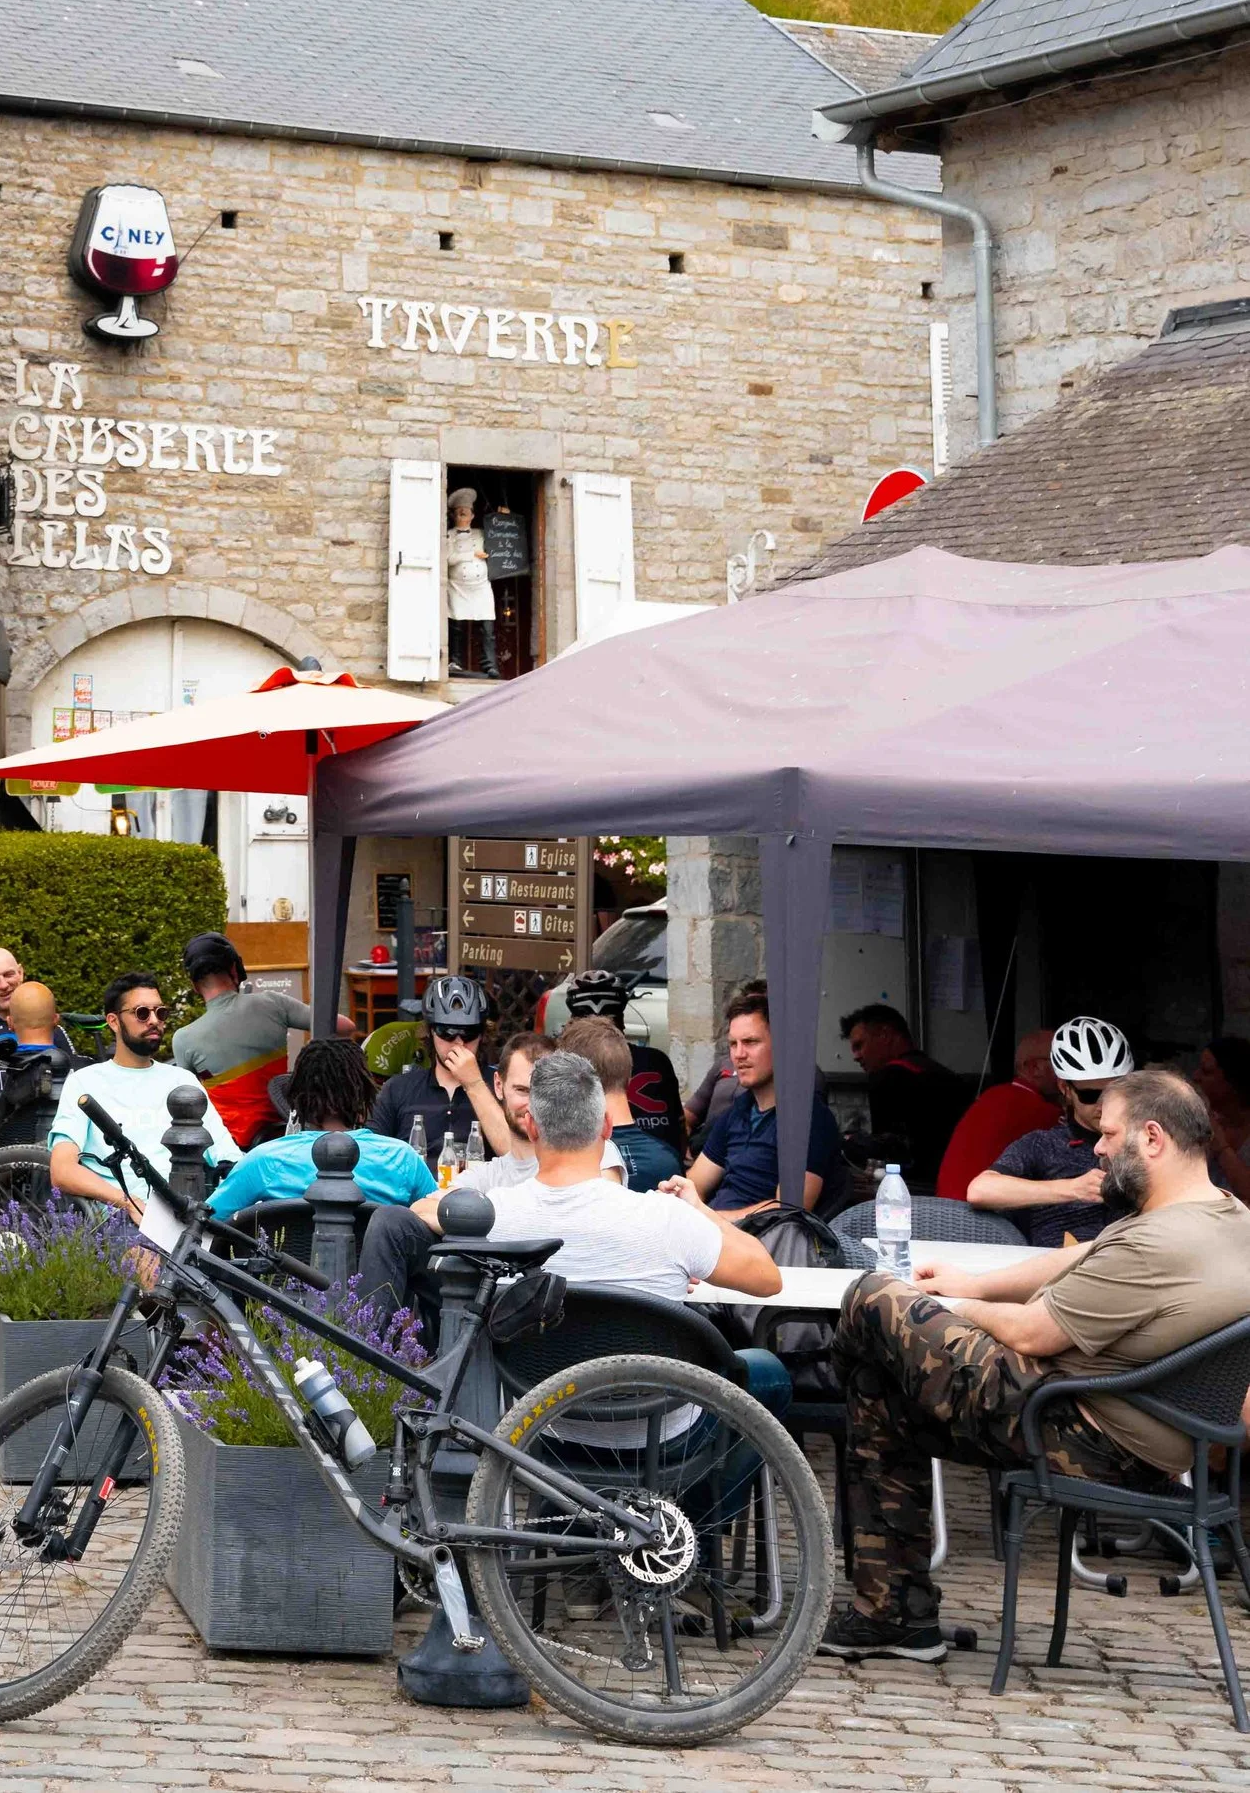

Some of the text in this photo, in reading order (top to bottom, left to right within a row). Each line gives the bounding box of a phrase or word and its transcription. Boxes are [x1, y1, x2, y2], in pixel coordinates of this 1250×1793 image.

[357, 297, 639, 368] TAVERNE
[12, 357, 83, 410] LA
[8, 412, 283, 477] CAUSERIE
[10, 463, 108, 518] DES
[7, 518, 172, 575] LILAS
[540, 848, 576, 869] Eglise
[510, 880, 575, 900] Restaurants
[544, 915, 575, 933] Gîtes
[461, 942, 503, 967] Parking
[255, 977, 292, 988] Causerie
[381, 1029, 411, 1056] Crelan
[138, 1406, 160, 1476] MAXXIS
[510, 1383, 576, 1446] MAXXIS
